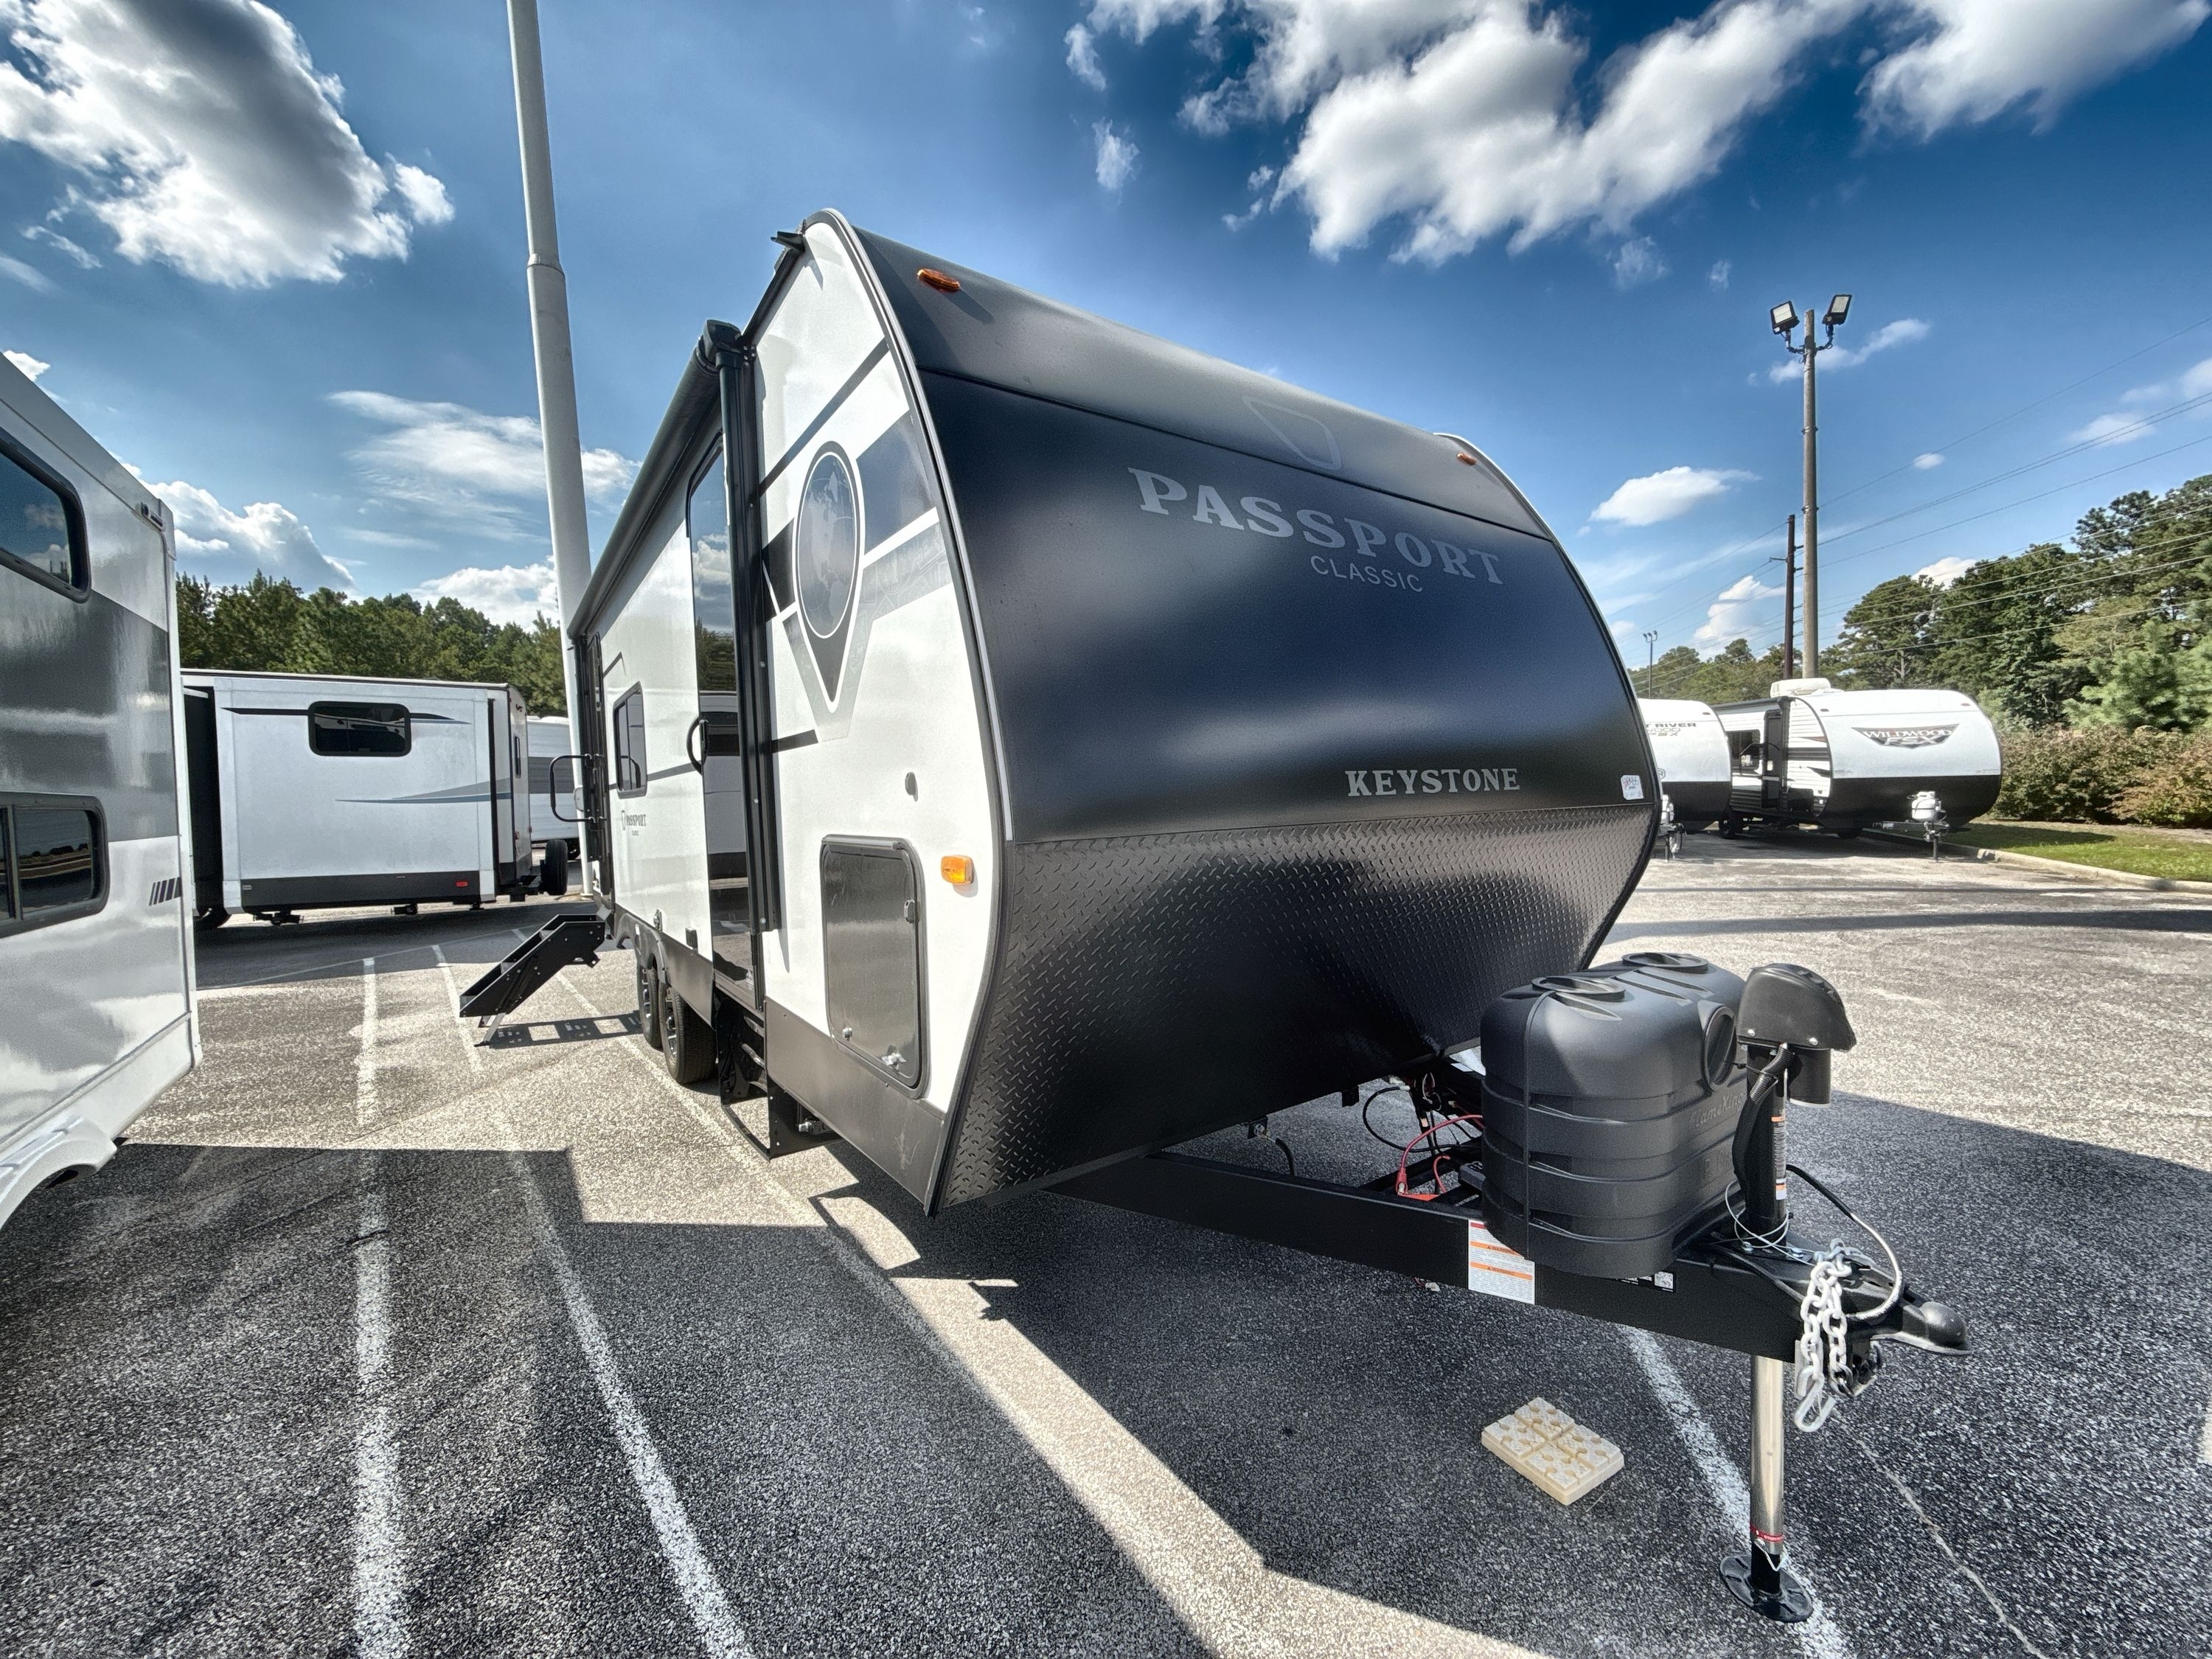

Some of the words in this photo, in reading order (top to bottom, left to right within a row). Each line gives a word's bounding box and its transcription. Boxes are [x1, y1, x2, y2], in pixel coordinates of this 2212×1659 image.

[1127, 467, 1503, 585] PASSPORT
[1310, 554, 1423, 592] CLASSIC
[1863, 729, 1952, 738] WILDWOOD
[1884, 736, 1938, 745] FSX
[1344, 768, 1520, 797] KEYSTONE
[1492, 1266, 1515, 1276] WARNING
